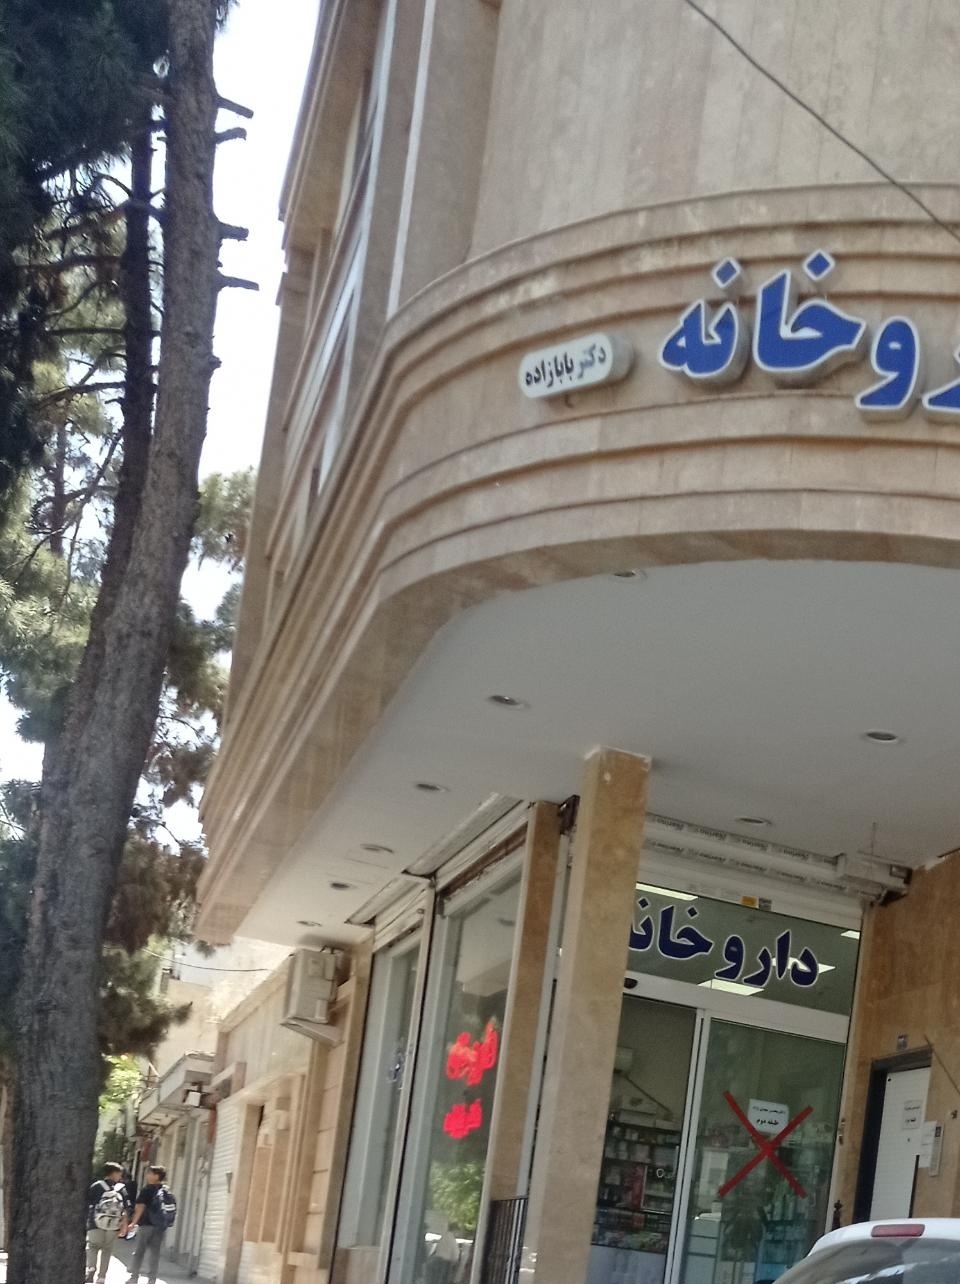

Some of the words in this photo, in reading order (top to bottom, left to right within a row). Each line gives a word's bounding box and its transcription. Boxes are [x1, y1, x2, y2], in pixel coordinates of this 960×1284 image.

[525, 352, 575, 388] بابازاده
[578, 343, 606, 380] دکتر
[628, 897, 819, 988] داروخان
